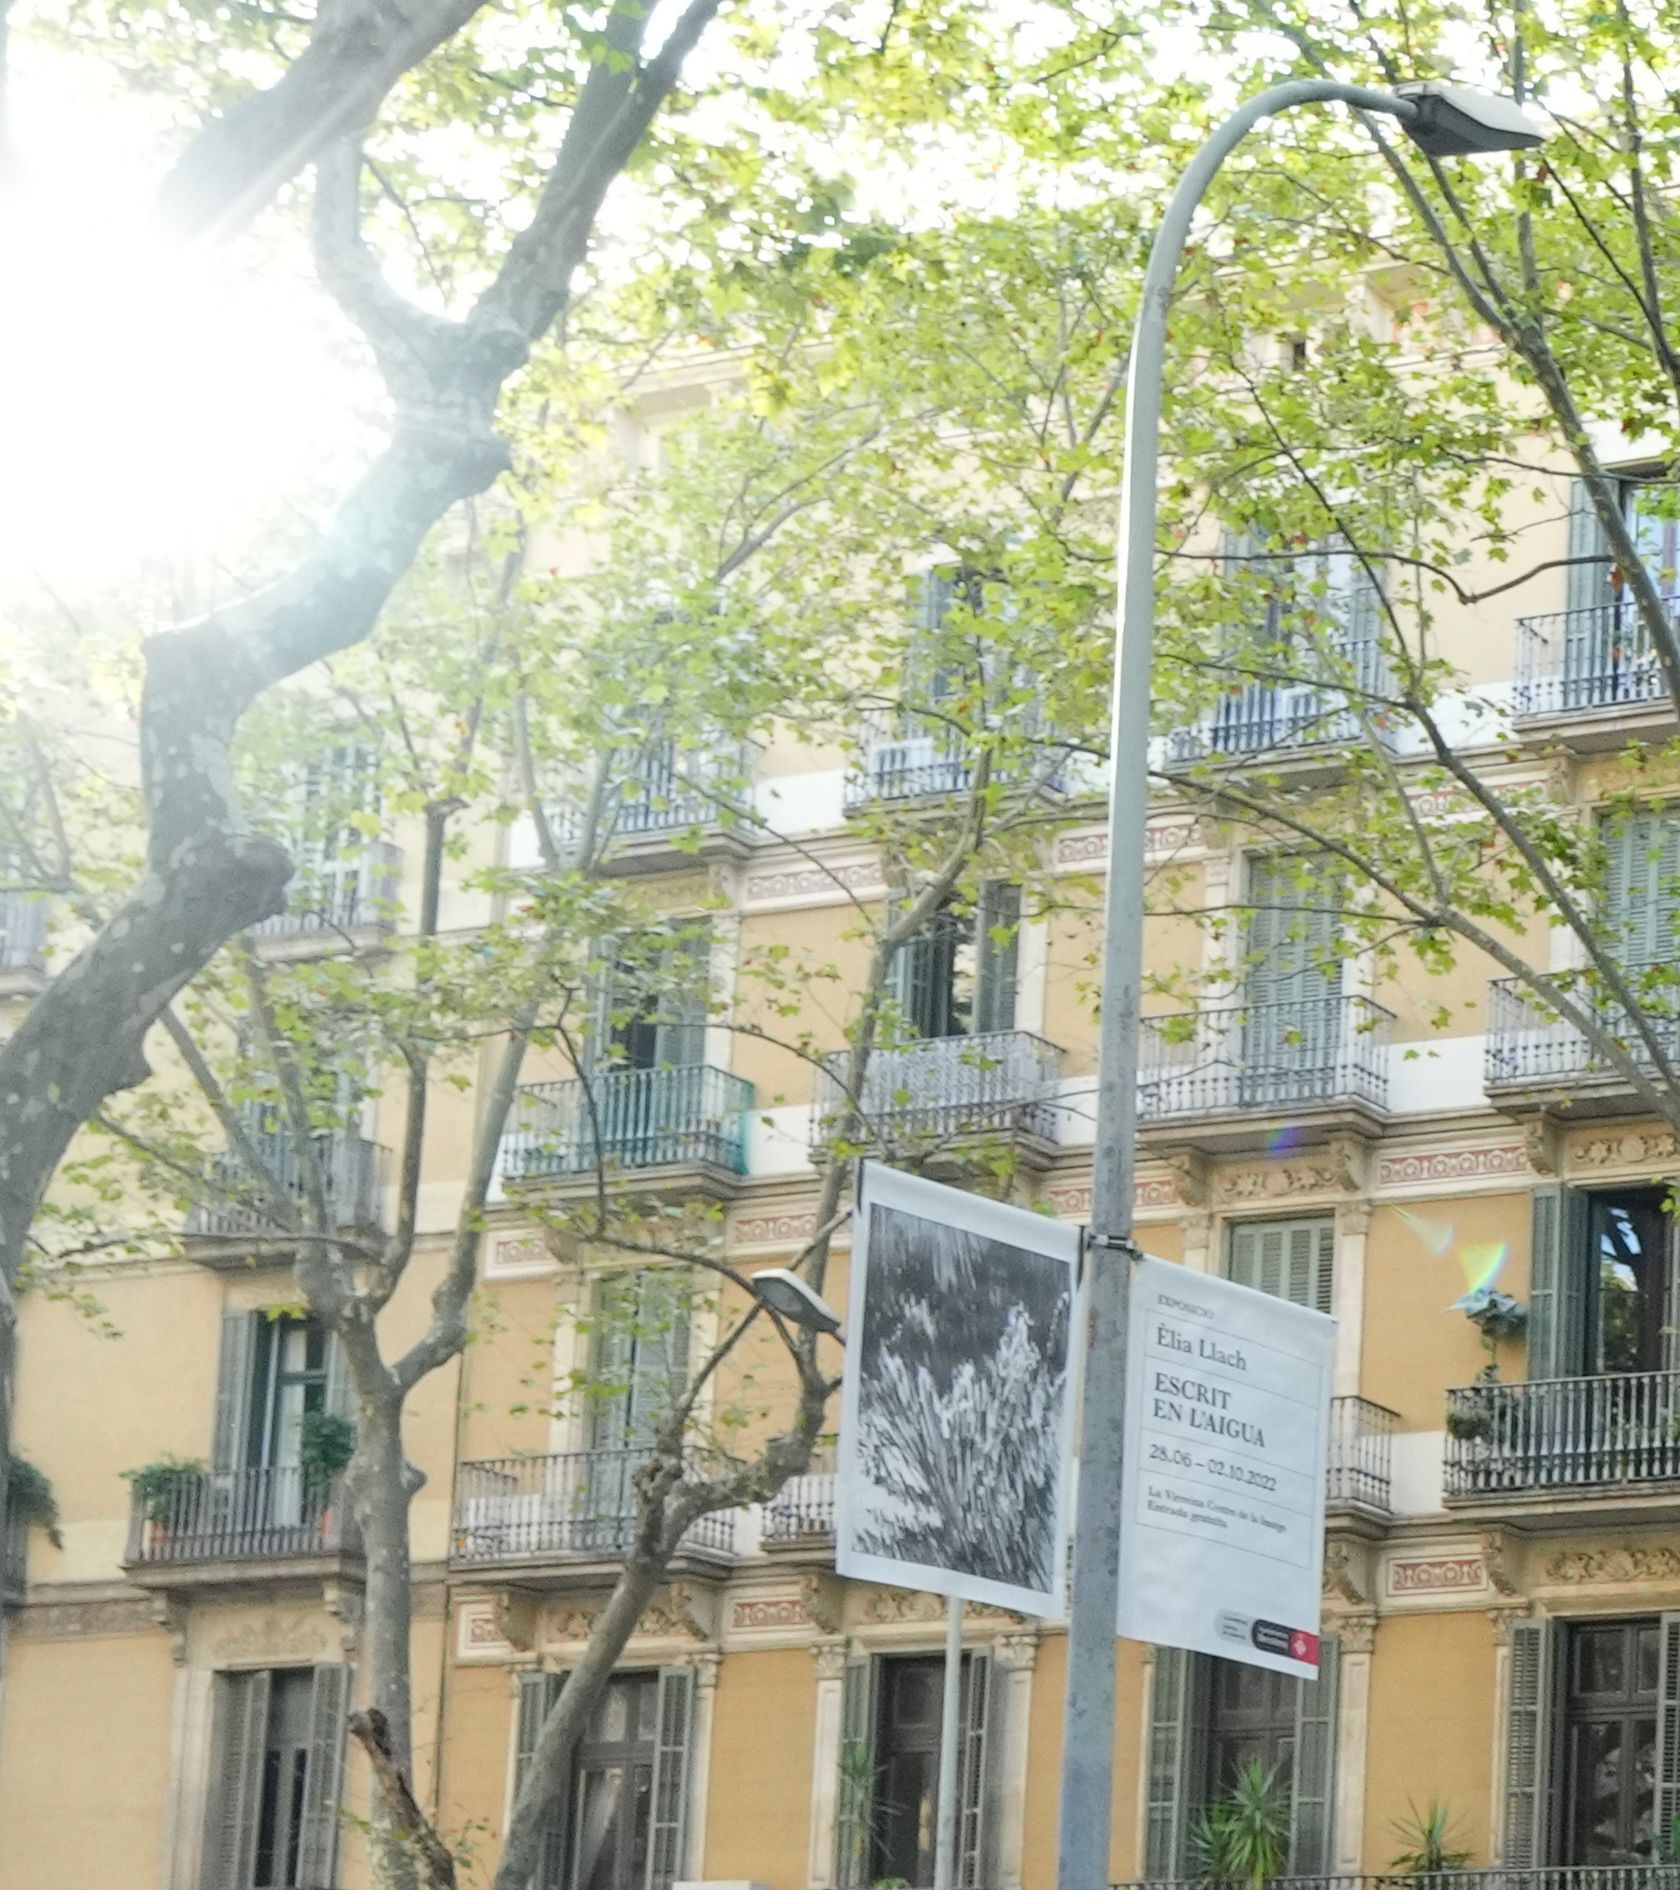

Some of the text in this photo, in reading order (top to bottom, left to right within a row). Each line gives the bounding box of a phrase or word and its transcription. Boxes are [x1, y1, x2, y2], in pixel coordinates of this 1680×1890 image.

[1199, 1339, 1247, 1371] Llach
[1155, 1372, 1232, 1410] ESCRIT
[1153, 1398, 1265, 1447] EN L'AIGUA
[1149, 1444, 1192, 1467] 28.06
